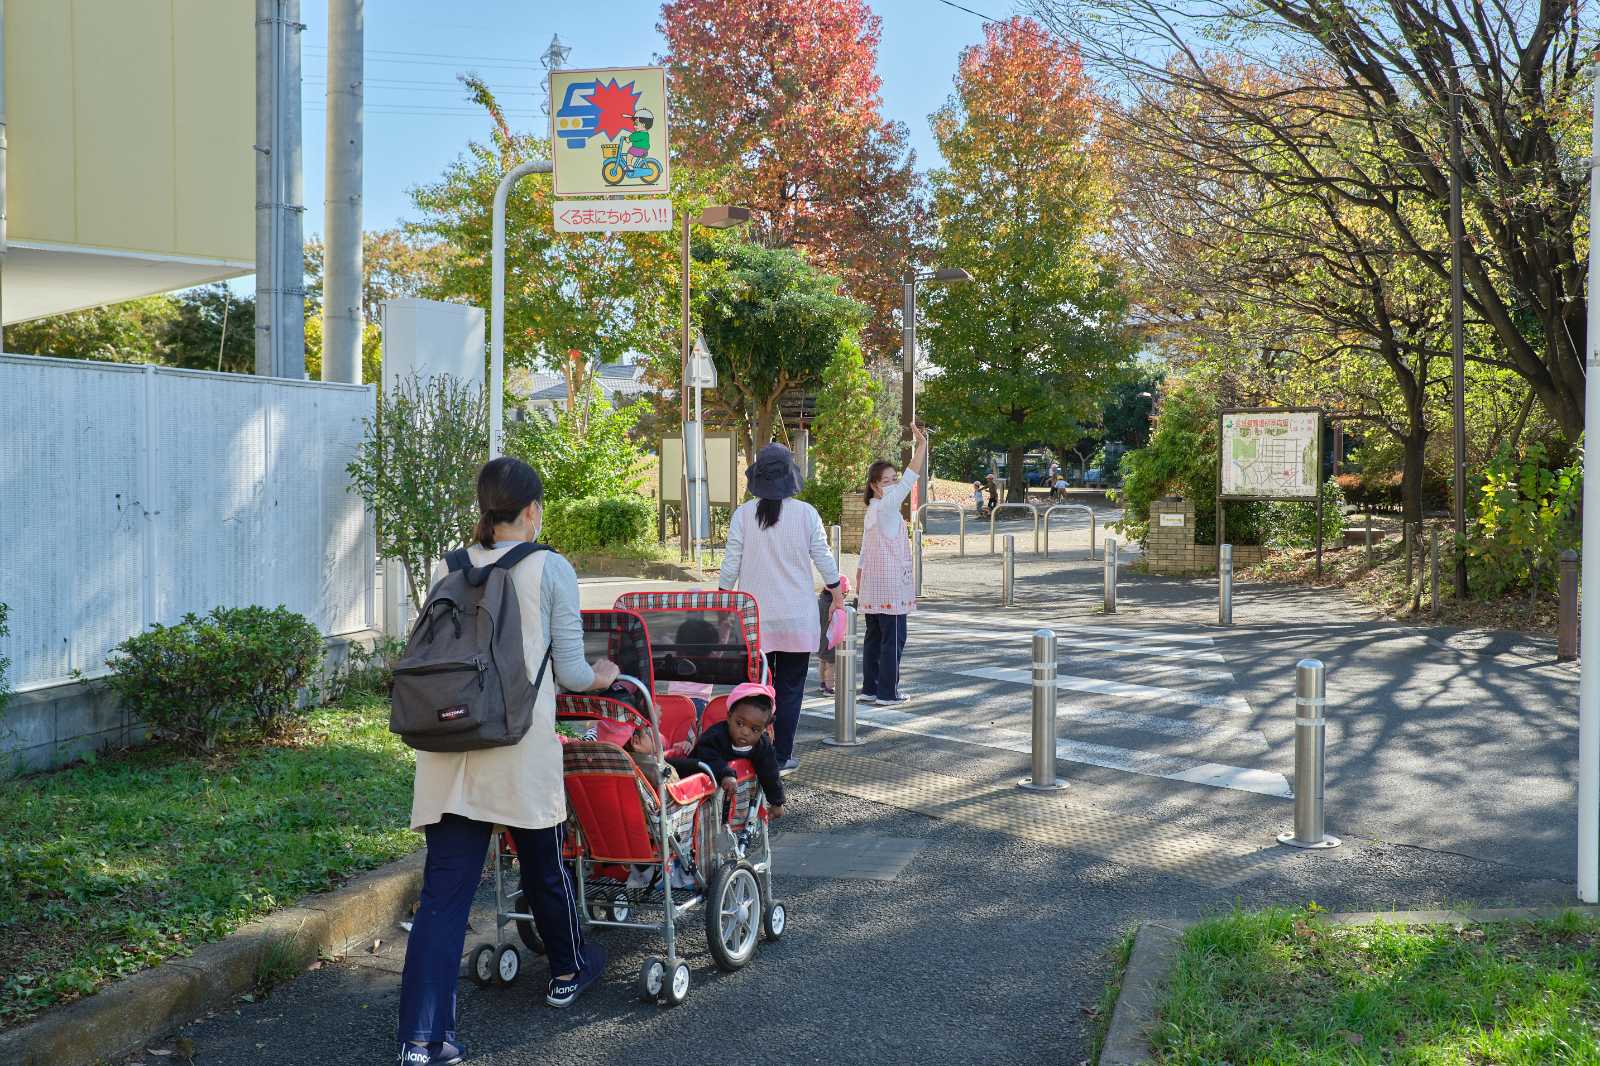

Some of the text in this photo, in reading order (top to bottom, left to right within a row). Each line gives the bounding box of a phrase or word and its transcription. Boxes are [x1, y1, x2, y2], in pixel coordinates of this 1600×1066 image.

[560, 207, 667, 225] くるまにちゅうい!!
